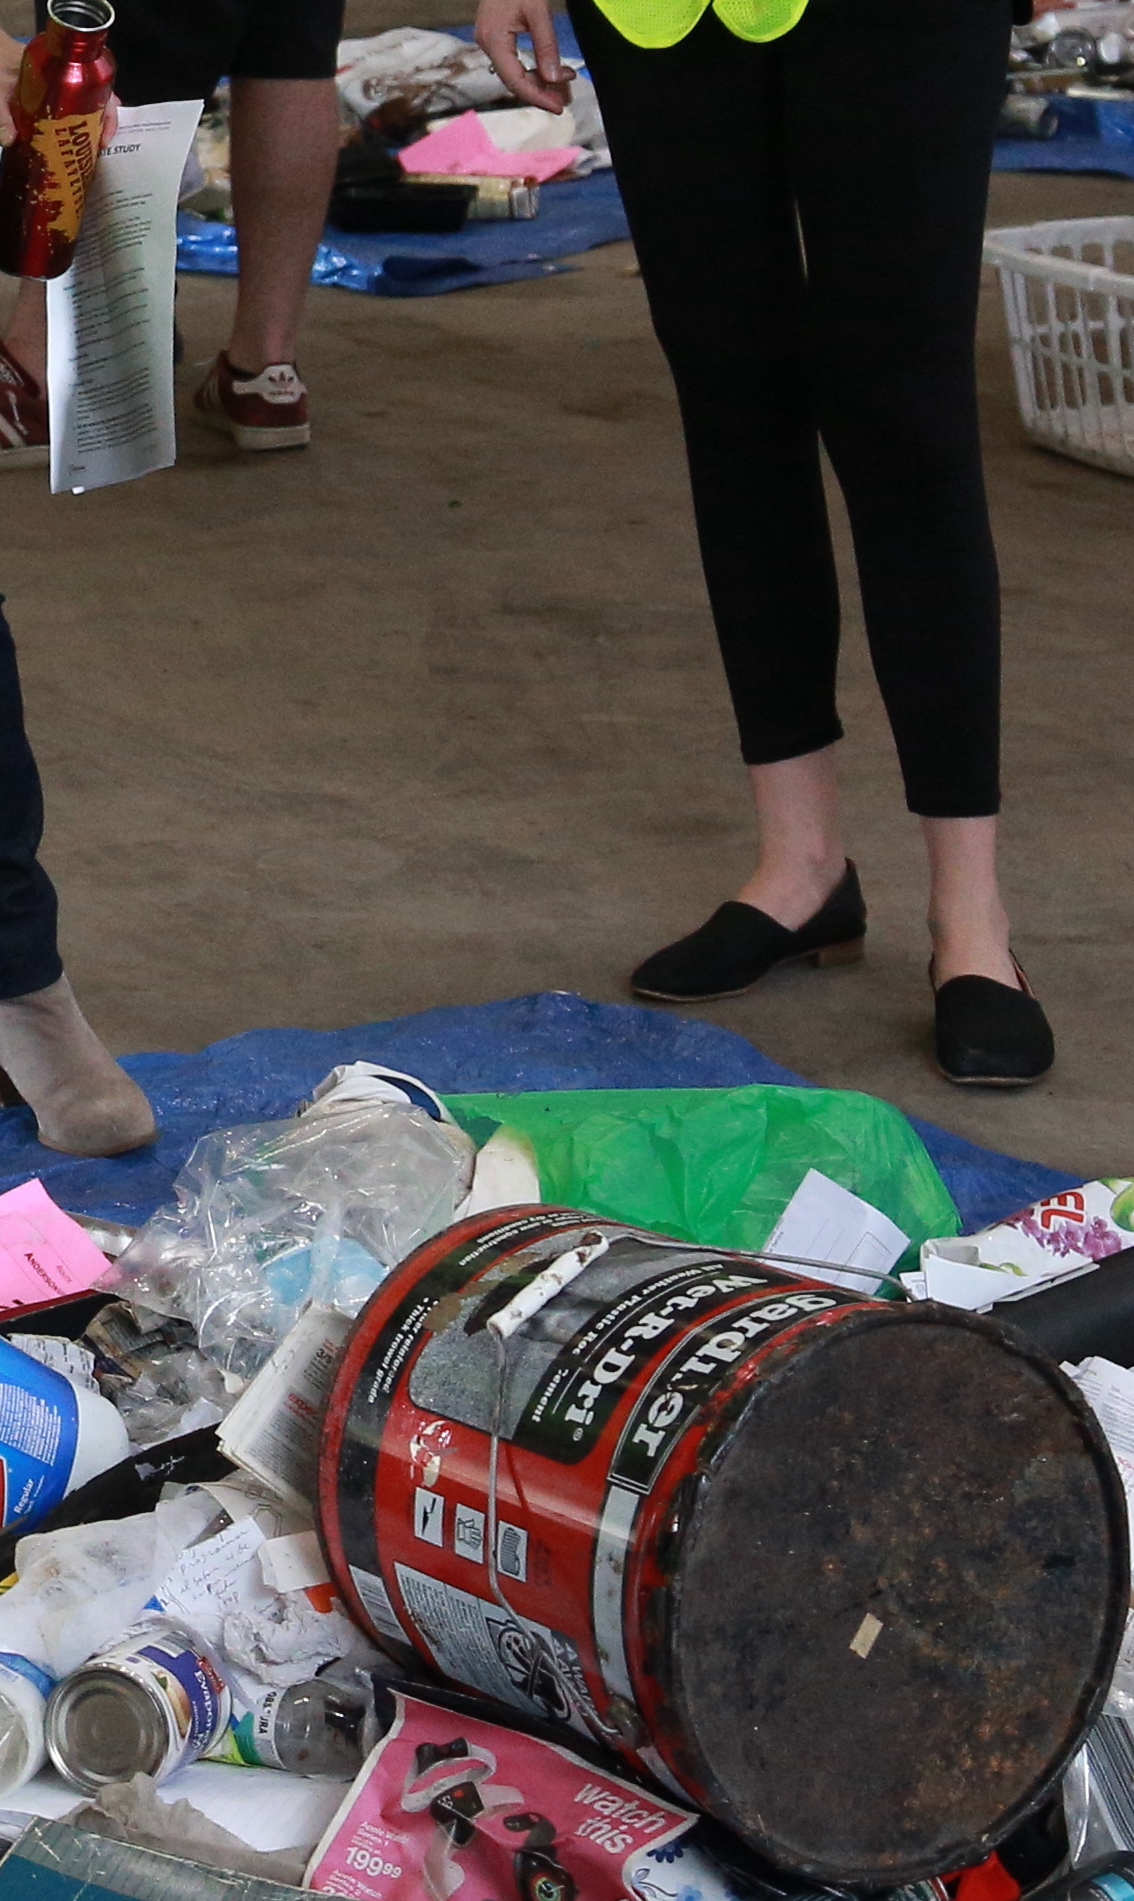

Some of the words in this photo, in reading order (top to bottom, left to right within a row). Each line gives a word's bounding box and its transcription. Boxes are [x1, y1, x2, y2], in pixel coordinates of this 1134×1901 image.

[114, 143, 141, 154] STUDY
[643, 1267, 702, 1295] Weather
[401, 1304, 425, 1332] Thick
[596, 1293, 643, 1330] Plastic
[381, 1333, 404, 1369] trowel
[367, 1368, 385, 1404] grade
[13, 1478, 34, 1514] Regular
[574, 1783, 668, 1834] watch
[574, 1818, 634, 1855] this
